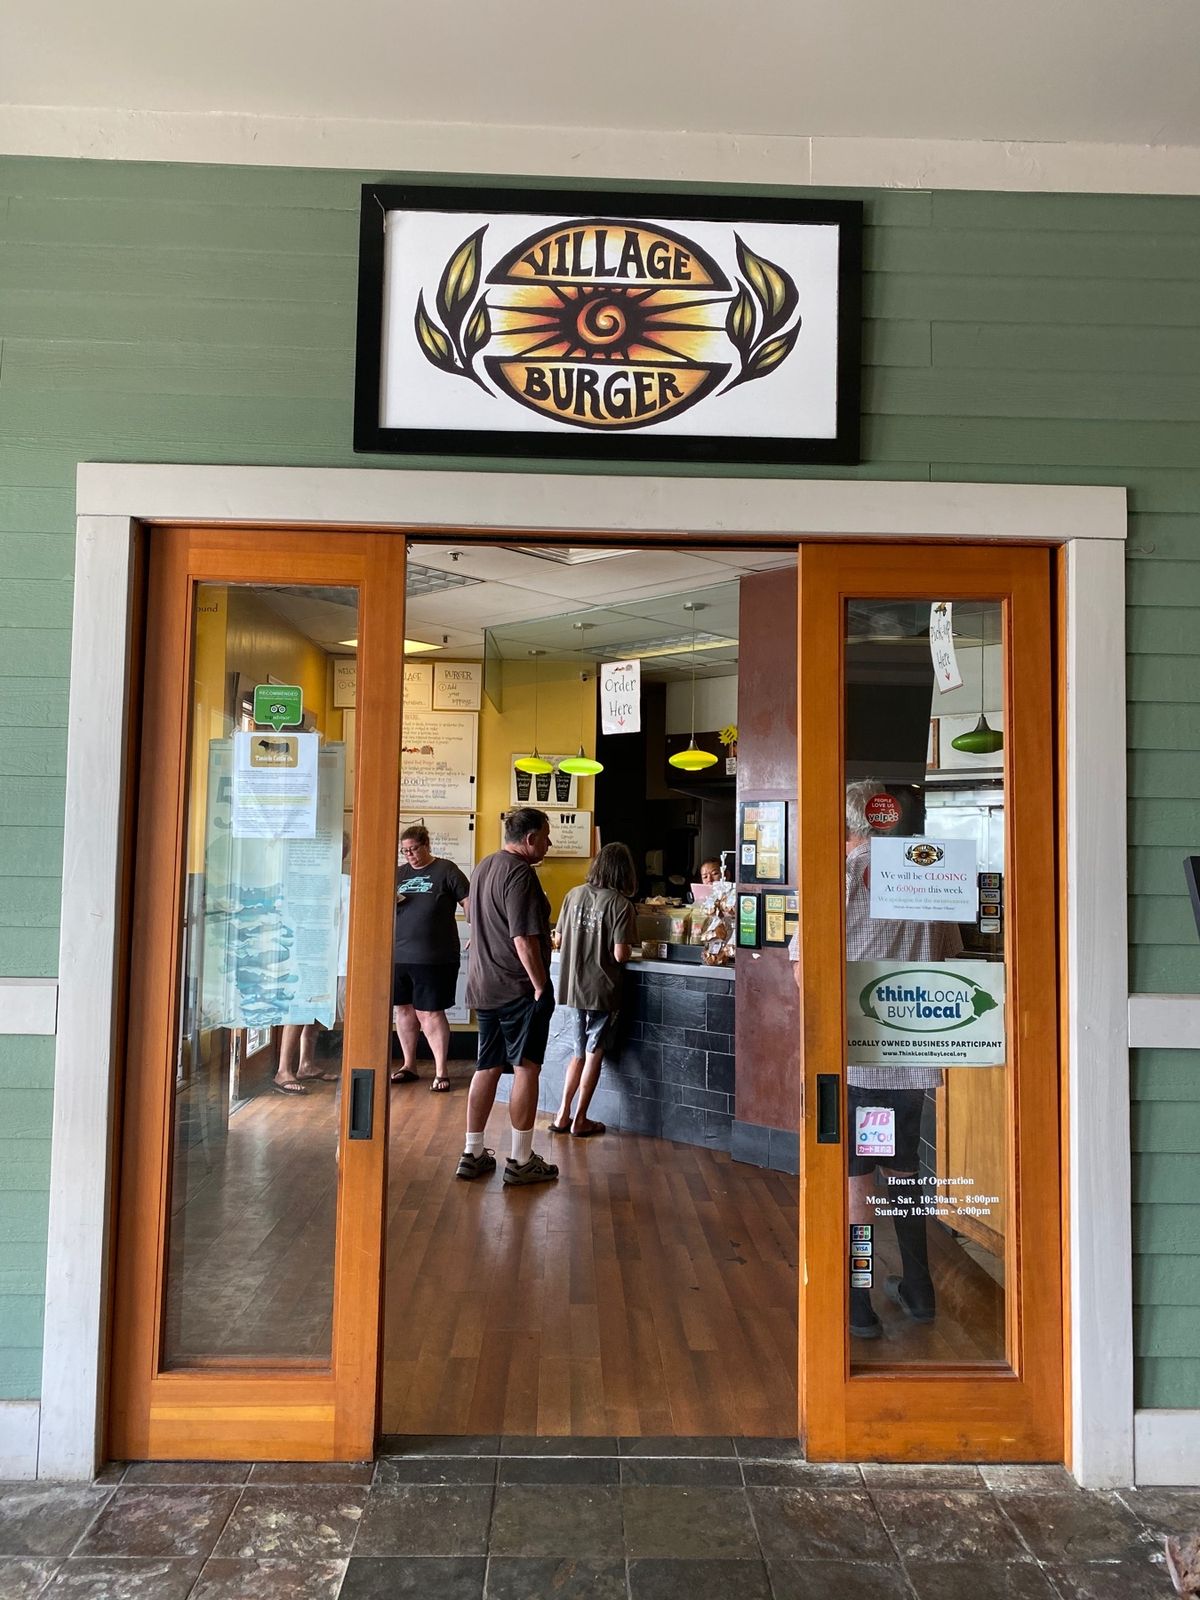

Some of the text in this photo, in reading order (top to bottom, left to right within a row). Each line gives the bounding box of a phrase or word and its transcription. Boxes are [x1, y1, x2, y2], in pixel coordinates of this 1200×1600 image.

[520, 230, 692, 281] VILLAGE
[522, 366, 685, 420] BURGER
[605, 675, 637, 693] Order
[609, 700, 632, 717] Here
[868, 812, 890, 823] yelp
[880, 871, 968, 881] We will be CLOSING
[896, 885, 926, 895] 6:00pm
[943, 886, 963, 894] week
[951, 1040, 1002, 1048] PARTICIPANT
[859, 1111, 891, 1129] JTB
[887, 1177, 974, 1187] Hours of Operation
[866, 1196, 890, 1205] Mon.
[897, 1196, 915, 1205] Sat.
[920, 1195, 958, 1204] 10:30am
[965, 1195, 1000, 1205] 8:00pm
[875, 1208, 909, 1218] Sunday
[911, 1207, 949, 1216] 10:30am
[957, 1207, 991, 1217] 6:00pm
